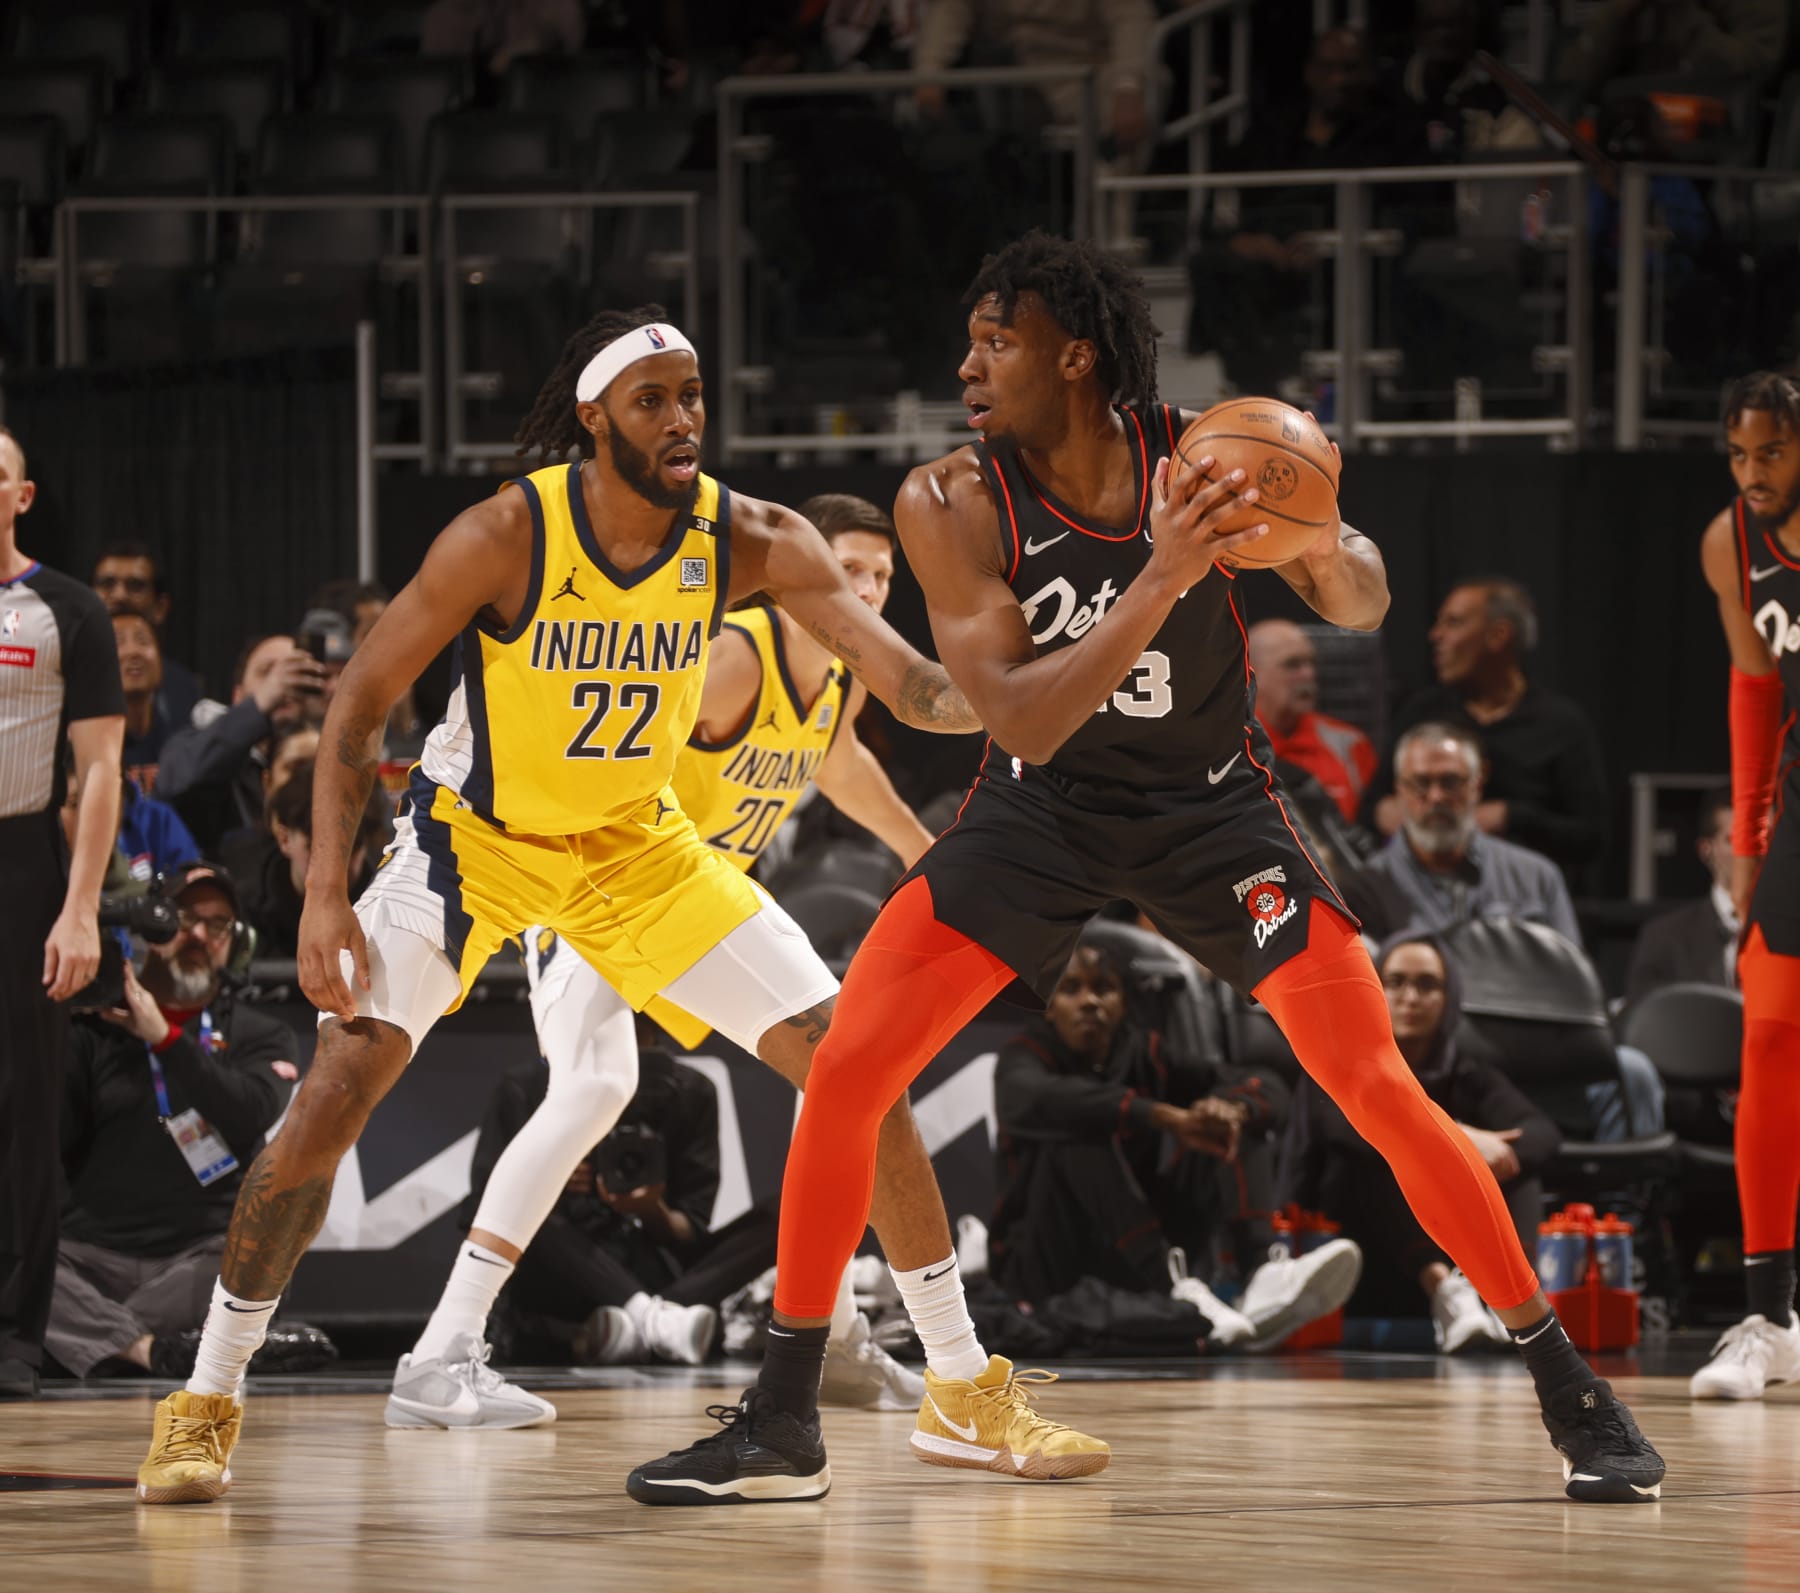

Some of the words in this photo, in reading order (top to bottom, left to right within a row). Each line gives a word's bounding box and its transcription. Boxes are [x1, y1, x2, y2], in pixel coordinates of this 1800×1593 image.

[530, 619, 703, 672] INDIANA
[1097, 650, 1173, 718] 3
[564, 680, 662, 760] 22
[704, 797, 786, 856] 20
[1232, 865, 1287, 903] PISTONS
[1253, 897, 1298, 949] Detroit
